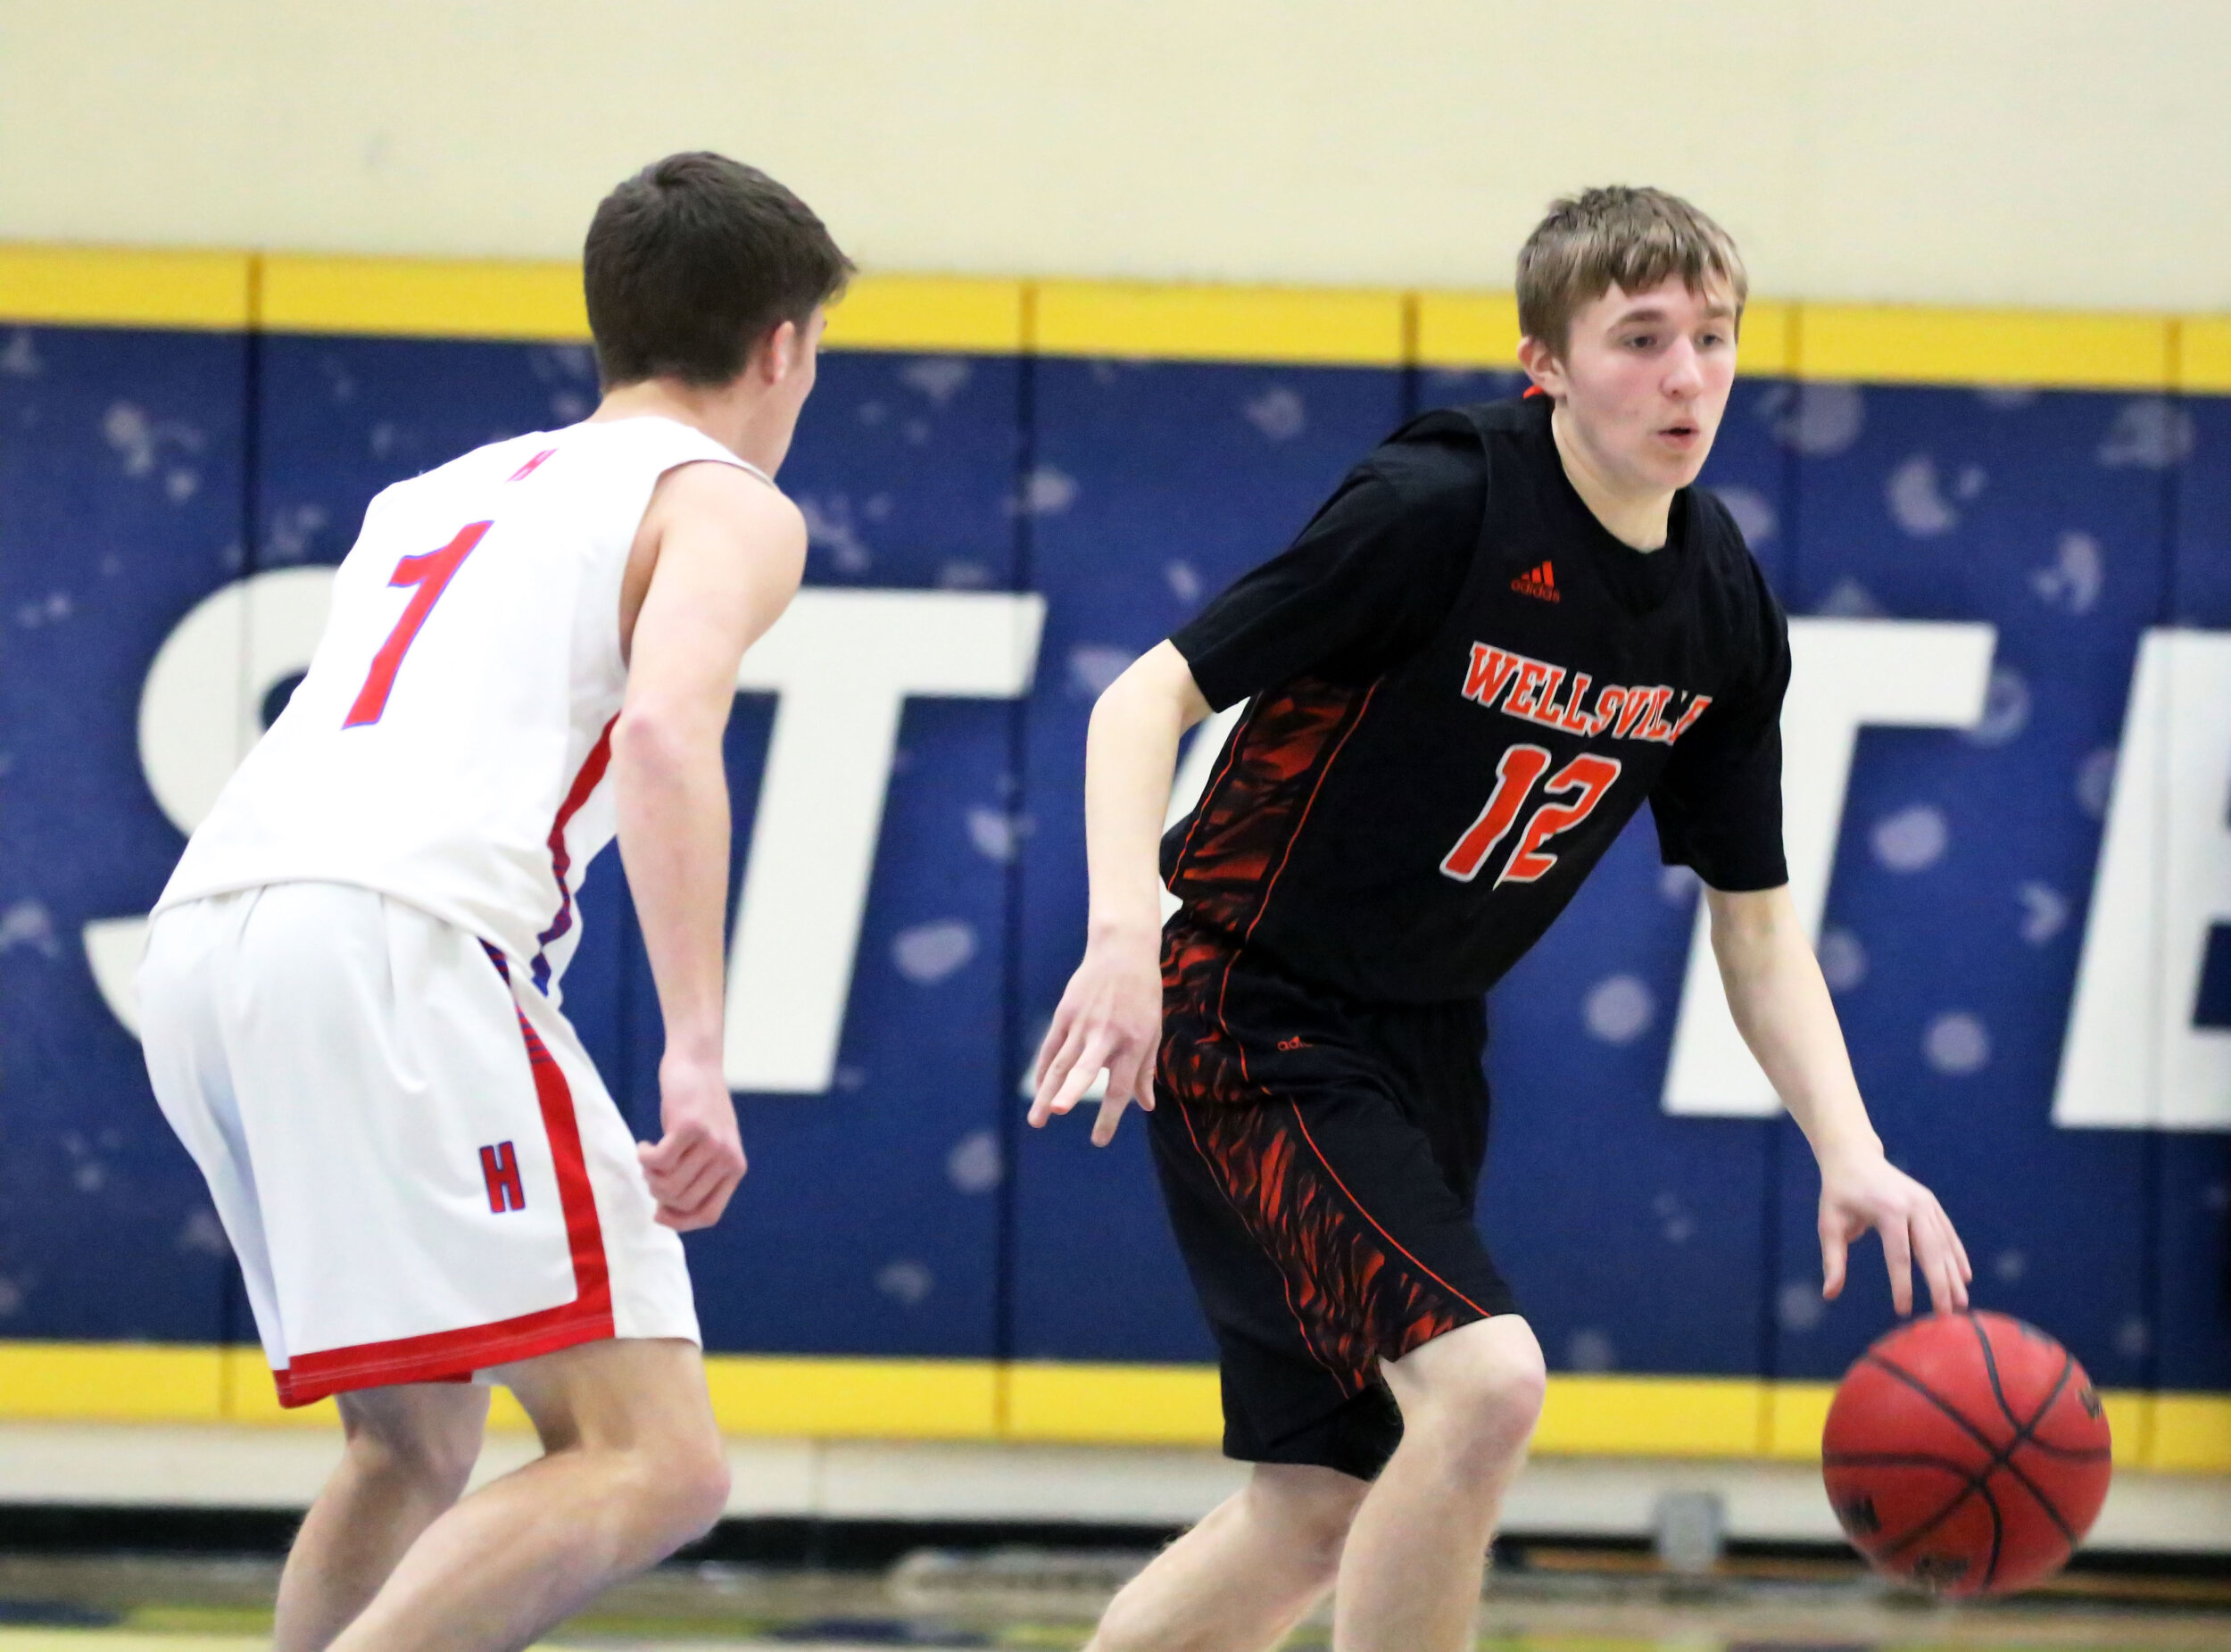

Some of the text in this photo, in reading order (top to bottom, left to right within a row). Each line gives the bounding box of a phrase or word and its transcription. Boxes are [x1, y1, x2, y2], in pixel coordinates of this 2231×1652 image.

[341, 519, 494, 730] 1
[1439, 743, 1621, 891] 12
[478, 1141, 526, 1214] H
